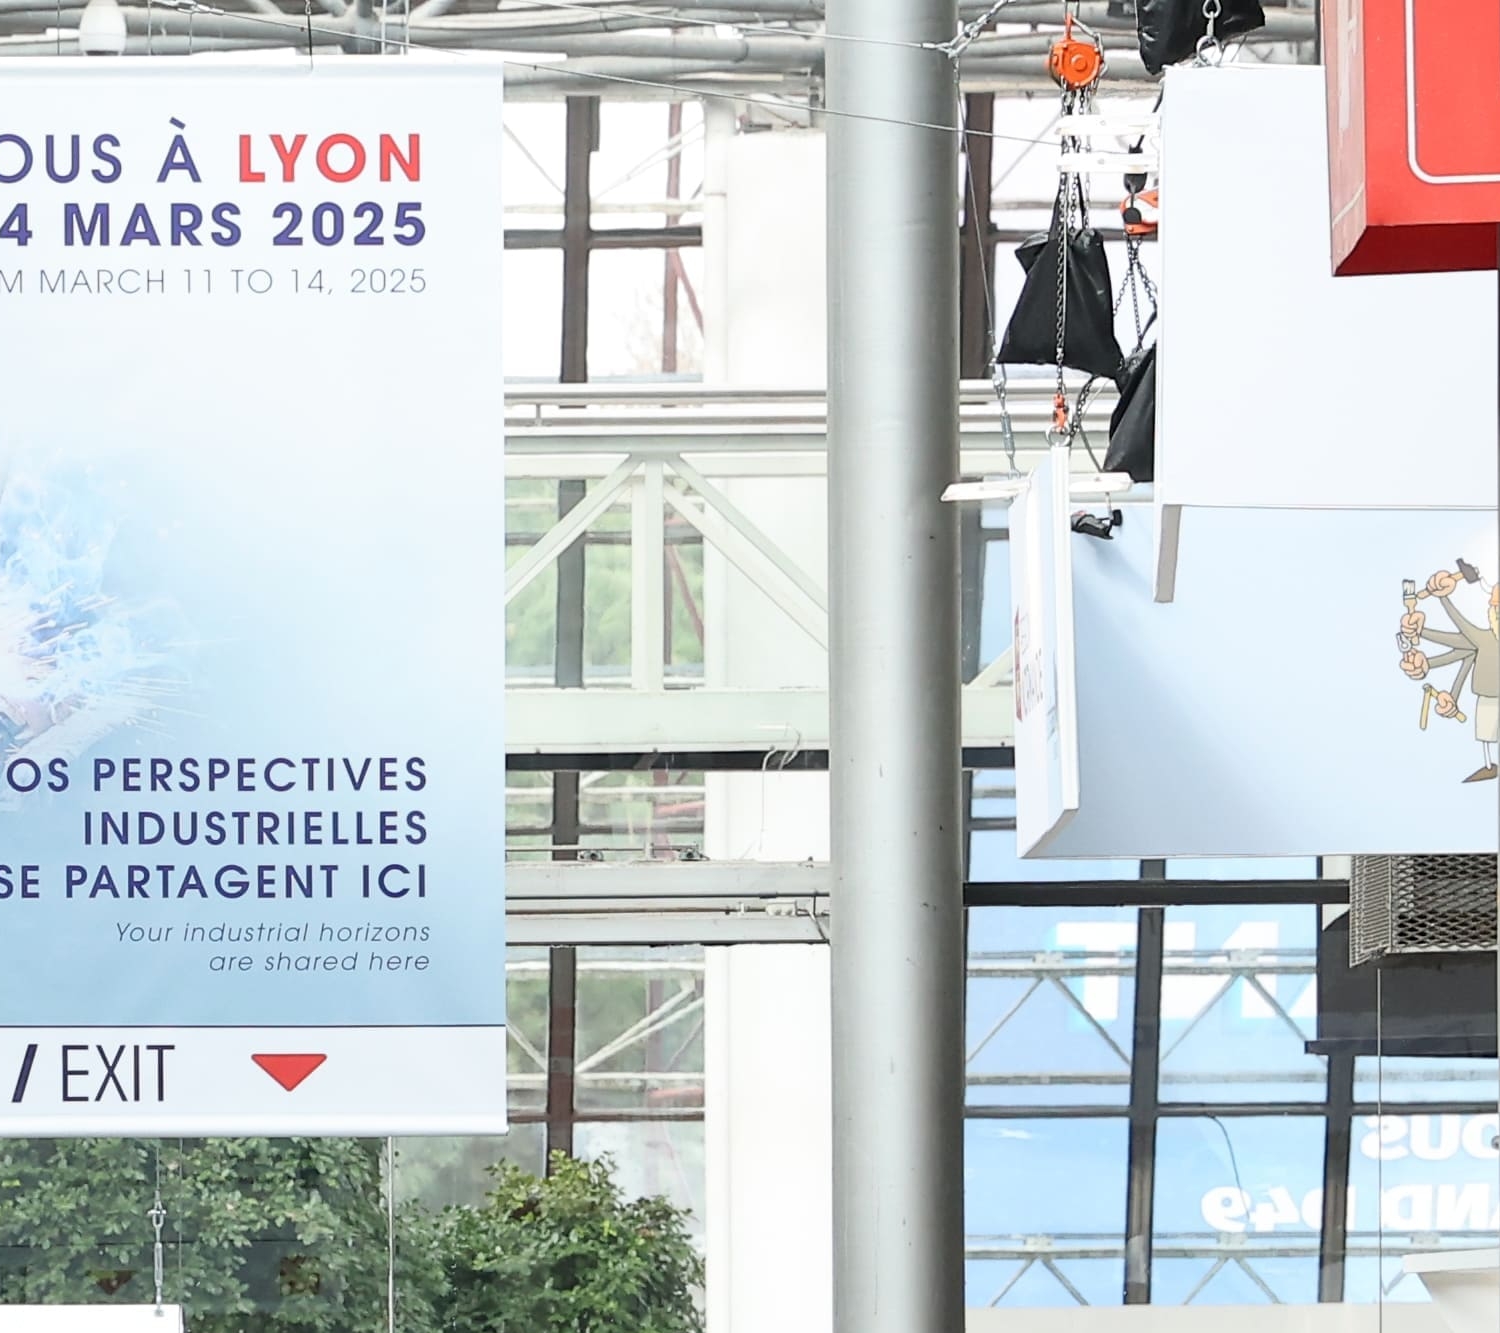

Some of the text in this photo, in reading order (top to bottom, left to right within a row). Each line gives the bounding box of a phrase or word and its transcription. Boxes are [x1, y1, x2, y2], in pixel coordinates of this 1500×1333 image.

[157, 118, 202, 183] À
[238, 133, 421, 183] LYON
[65, 203, 242, 247] MARS
[273, 201, 426, 247] 2025
[40, 268, 166, 295] MARCH
[182, 268, 219, 294] 11
[231, 268, 273, 295] TO
[286, 268, 334, 297] 14,
[350, 268, 426, 294] 2025
[93, 756, 427, 793] PERSPECTIVES
[84, 811, 427, 846] INDUSTRIELLES
[65, 864, 339, 900] PARTAGENT
[361, 863, 426, 899] ICI
[116, 921, 430, 943] Your industrial horizons
[208, 950, 430, 972] are shared here
[12, 1043, 36, 1104] /
[61, 1045, 174, 1103] EXIT
